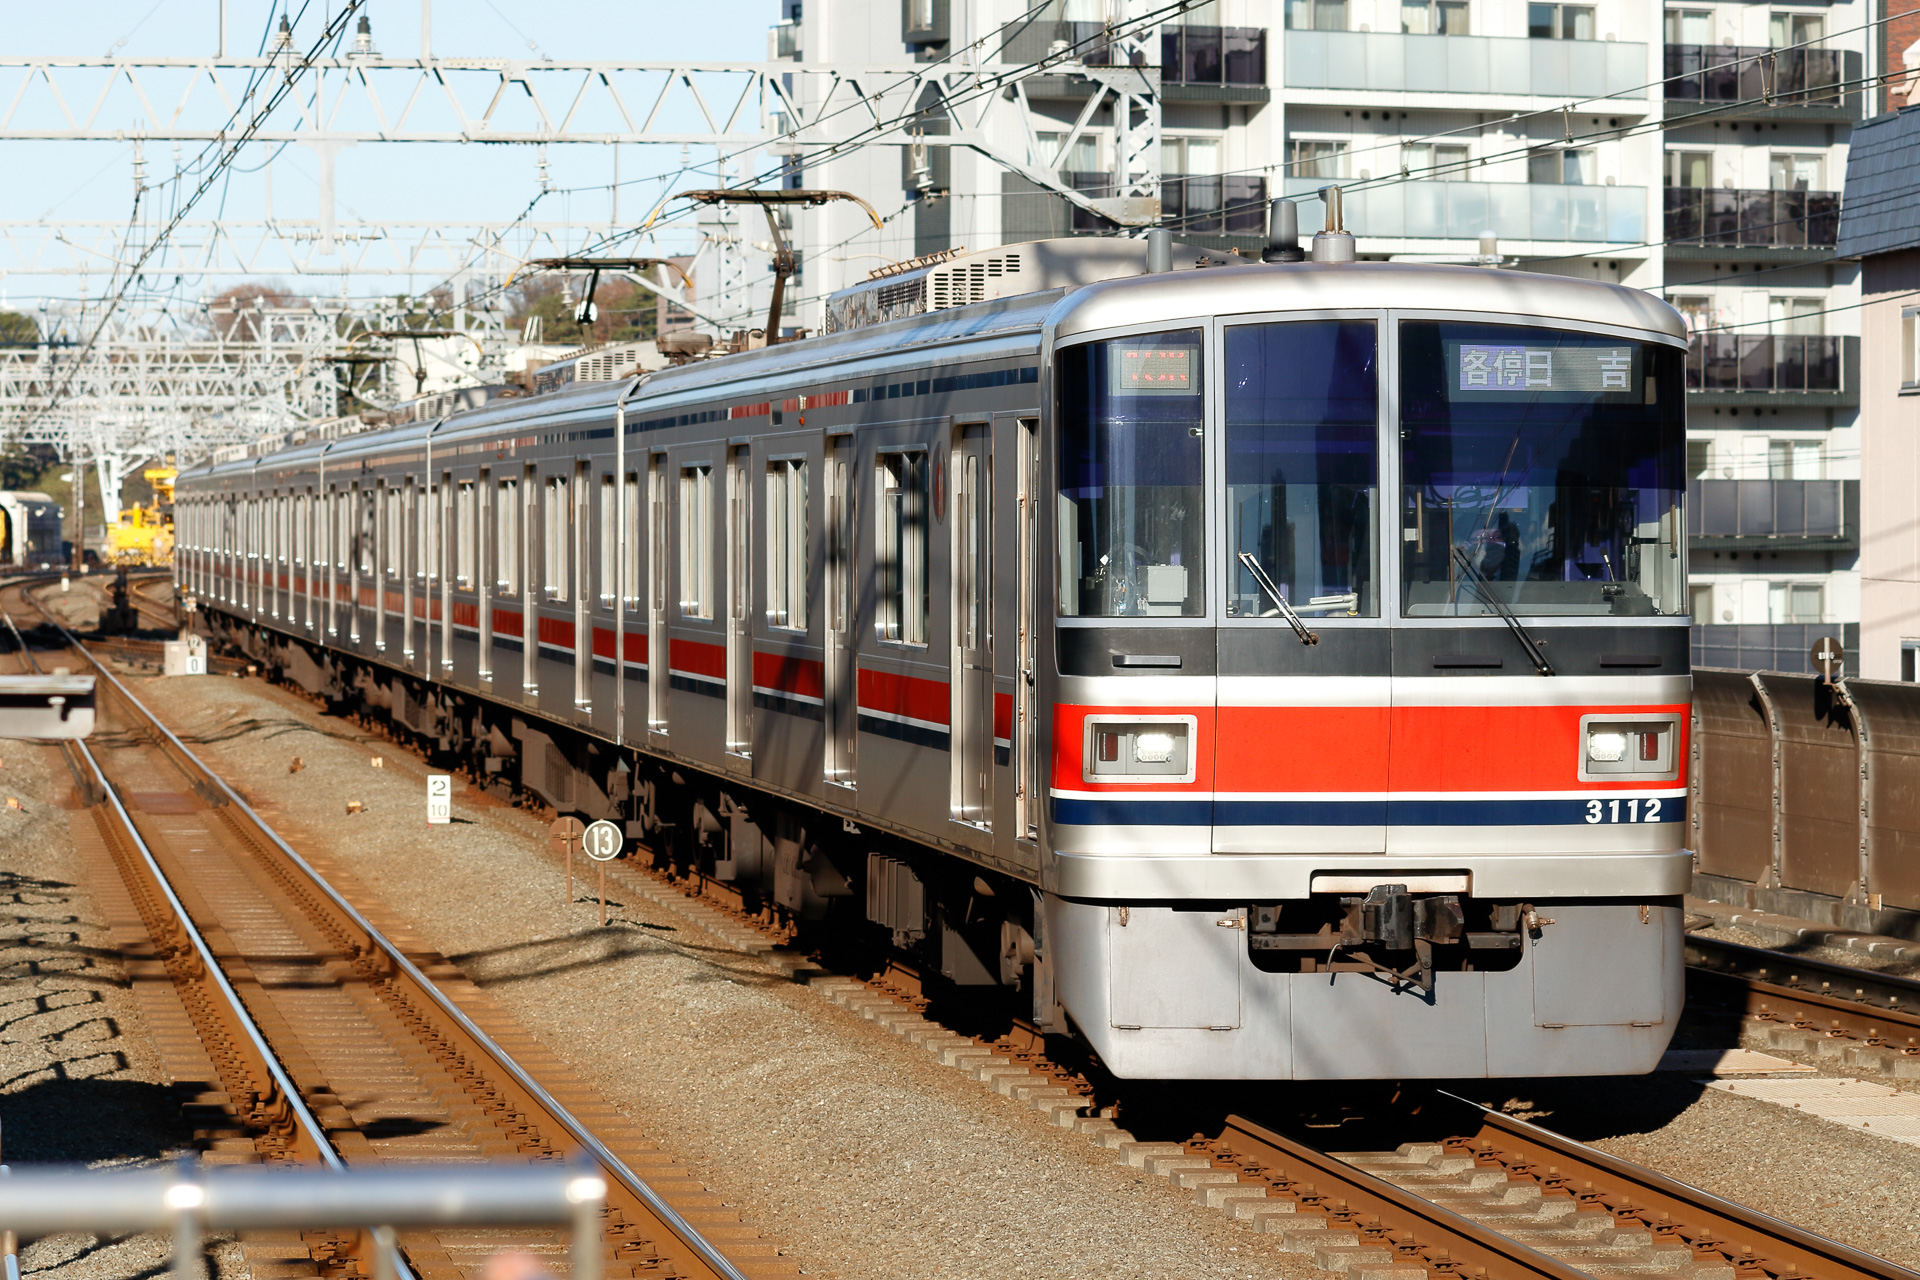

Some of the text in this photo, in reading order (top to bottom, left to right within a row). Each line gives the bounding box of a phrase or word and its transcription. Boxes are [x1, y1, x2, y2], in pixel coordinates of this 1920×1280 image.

[1462, 349, 1523, 386] 各停
[191, 658, 198, 672] 0
[432, 780, 446, 796] 2
[431, 804, 447, 817] 10
[1585, 798, 1662, 824] 3112
[592, 826, 614, 856] 13
